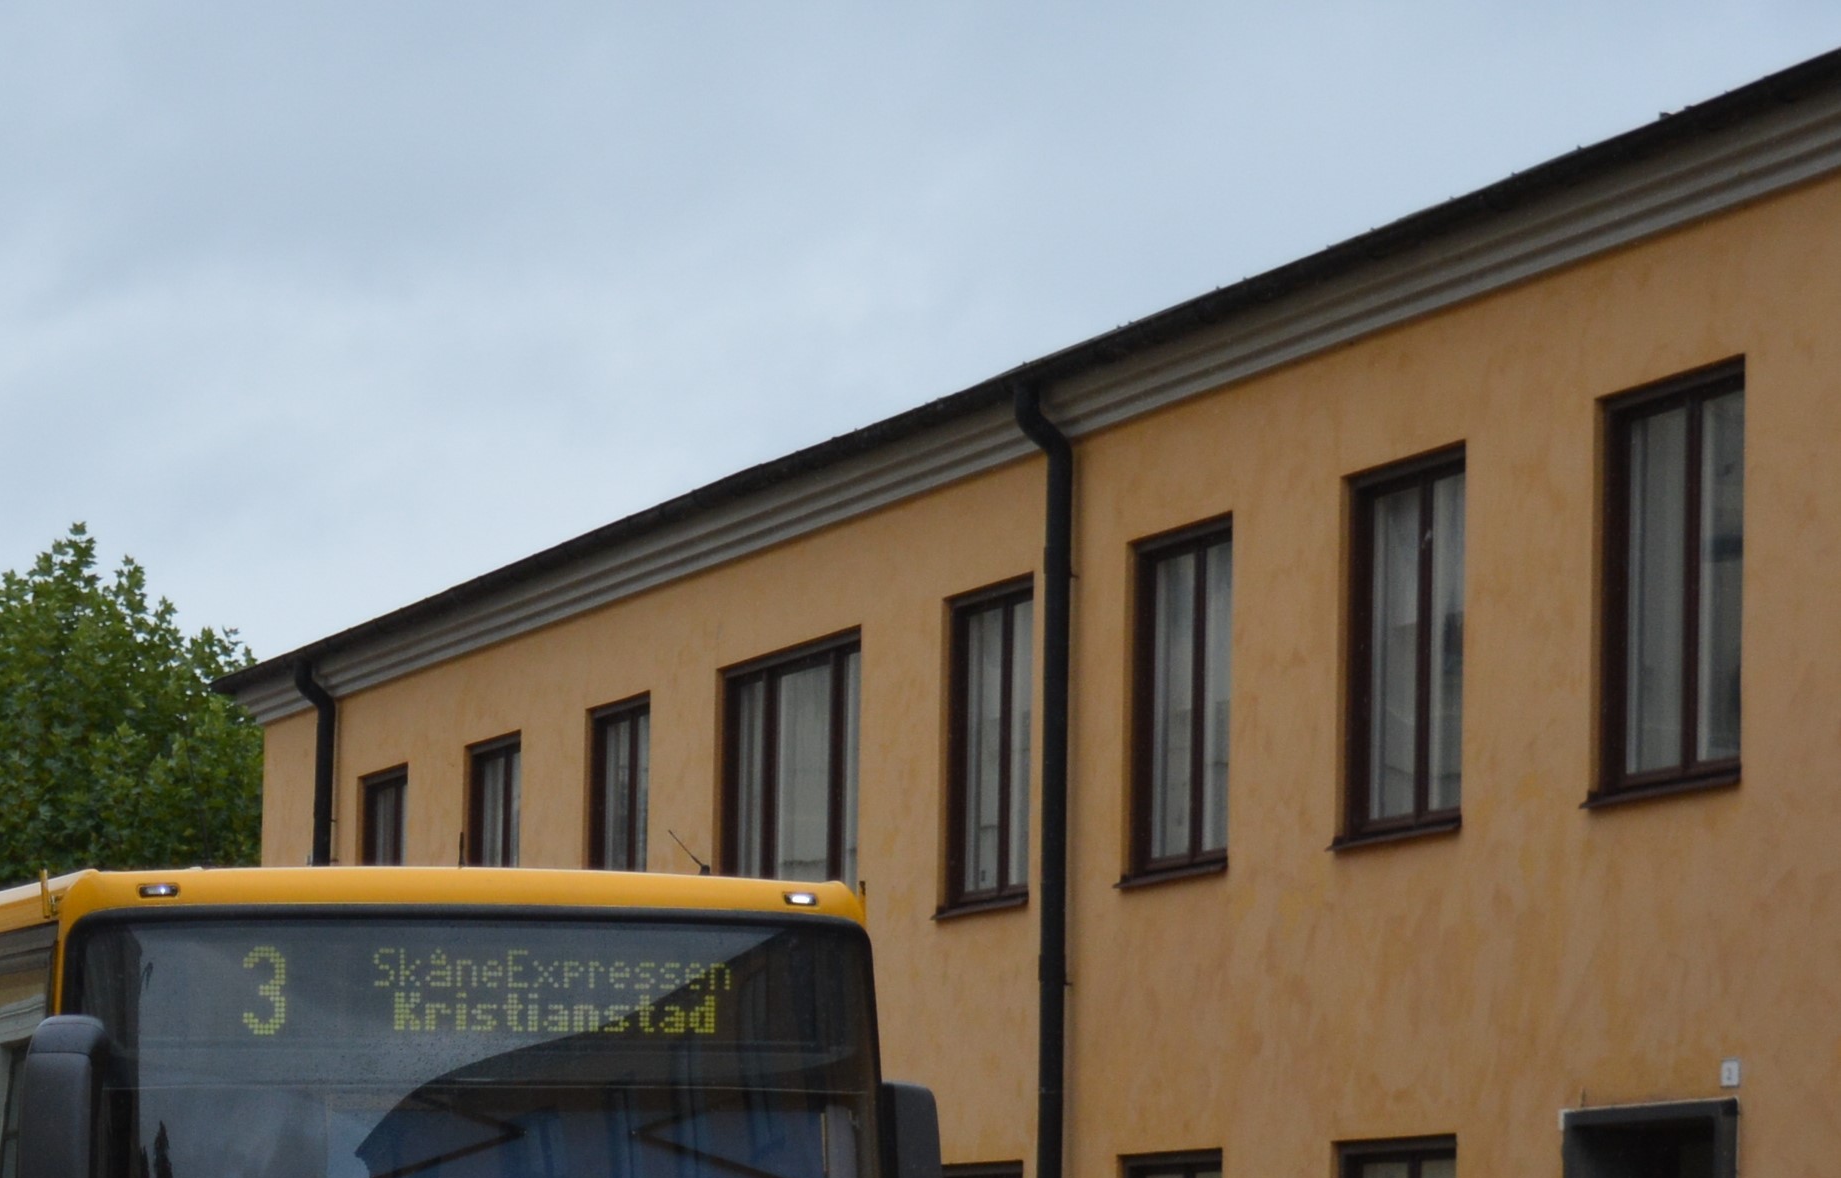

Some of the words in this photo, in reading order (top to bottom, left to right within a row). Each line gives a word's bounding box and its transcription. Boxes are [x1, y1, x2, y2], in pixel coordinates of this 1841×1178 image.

[242, 945, 286, 1036] 3
[373, 946, 732, 991] SkåneExpressen
[393, 991, 717, 1034] Kristianstad
